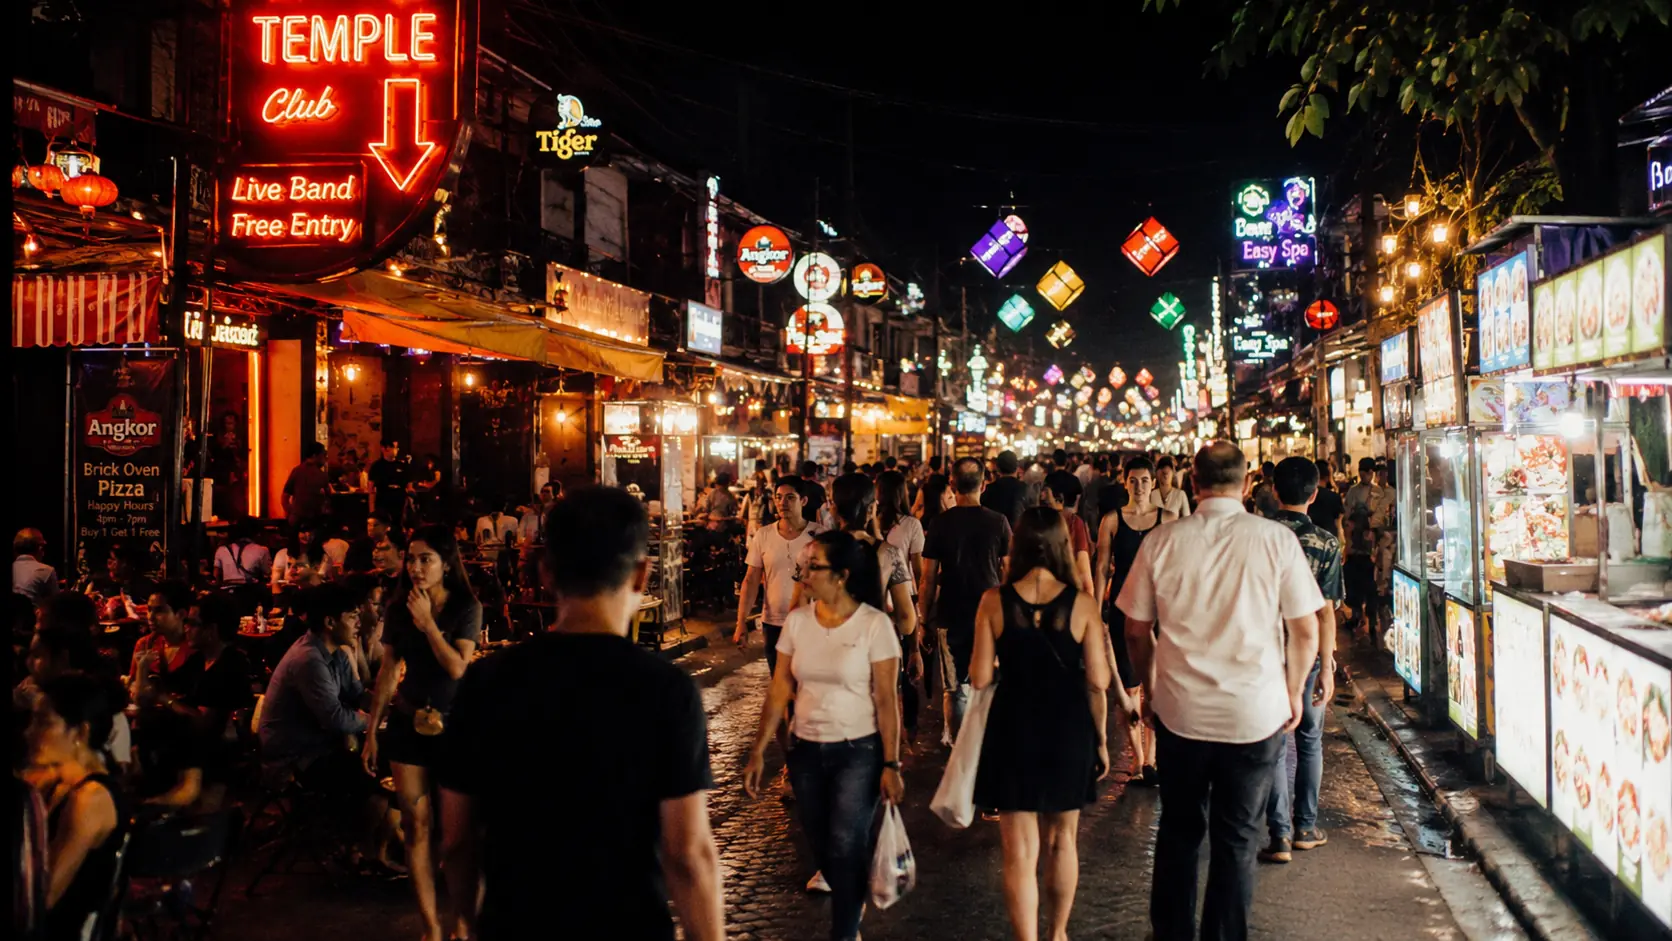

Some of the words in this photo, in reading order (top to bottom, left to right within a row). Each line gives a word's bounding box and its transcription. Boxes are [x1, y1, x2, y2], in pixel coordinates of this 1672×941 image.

[253, 13, 437, 63] TEMPLE
[261, 86, 337, 124] Club
[535, 128, 598, 160] Tiger
[231, 176, 282, 202] Live
[289, 174, 355, 201] Band
[231, 213, 283, 237] Free
[290, 212, 354, 242] Entry
[1243, 240, 1277, 264] Easy
[1281, 238, 1309, 264] Spa
[87, 418, 157, 442] Angkor
[84, 462, 120, 476] Brick
[123, 462, 160, 477] Oven
[98, 479, 145, 497] Pizza
[87, 500, 120, 512] Happy
[123, 500, 154, 511] Hours
[81, 527, 98, 538] Buy
[111, 527, 128, 537] Get
[139, 527, 160, 537] Free
